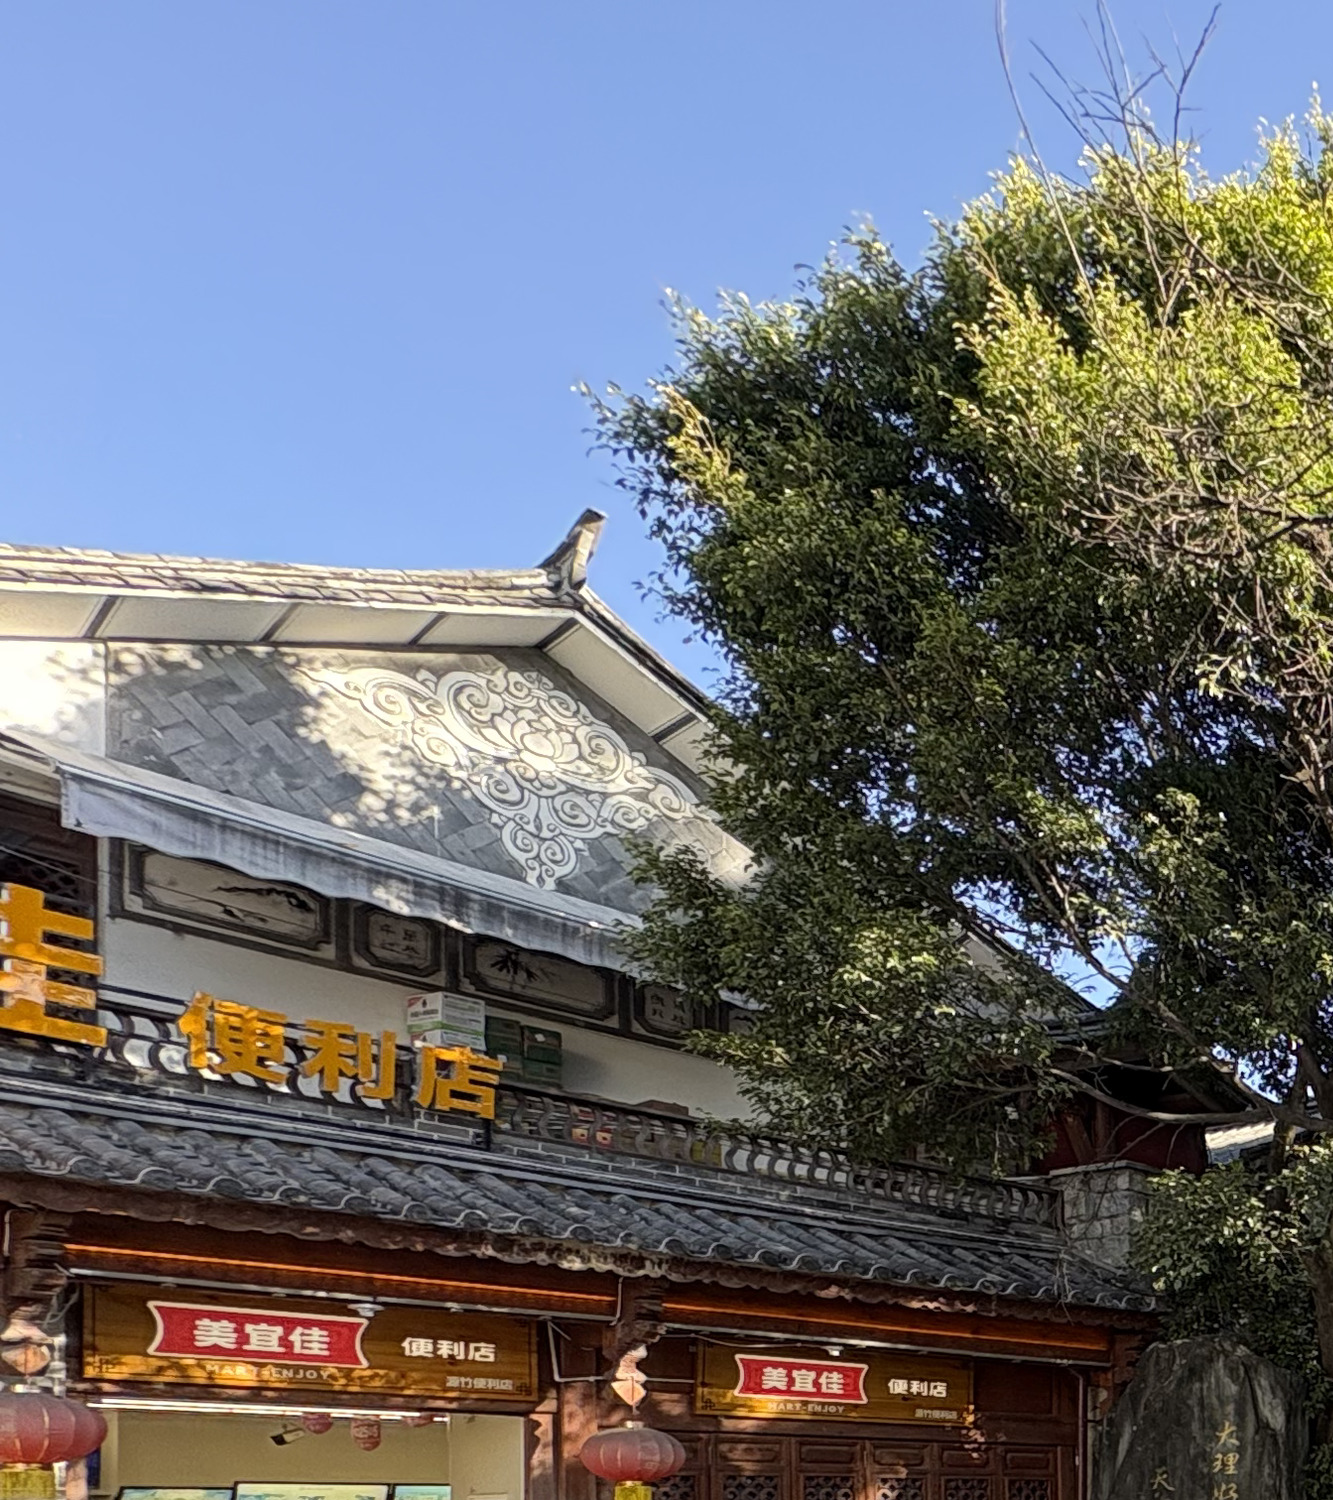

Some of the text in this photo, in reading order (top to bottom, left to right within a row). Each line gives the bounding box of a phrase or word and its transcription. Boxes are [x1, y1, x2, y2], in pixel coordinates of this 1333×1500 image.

[179, 991, 506, 1121] 便利店
[193, 1318, 331, 1357] 美宜佳
[400, 1336, 496, 1363] 便利店
[761, 1366, 845, 1395] 美宜佳
[887, 1378, 948, 1398] 便利店
